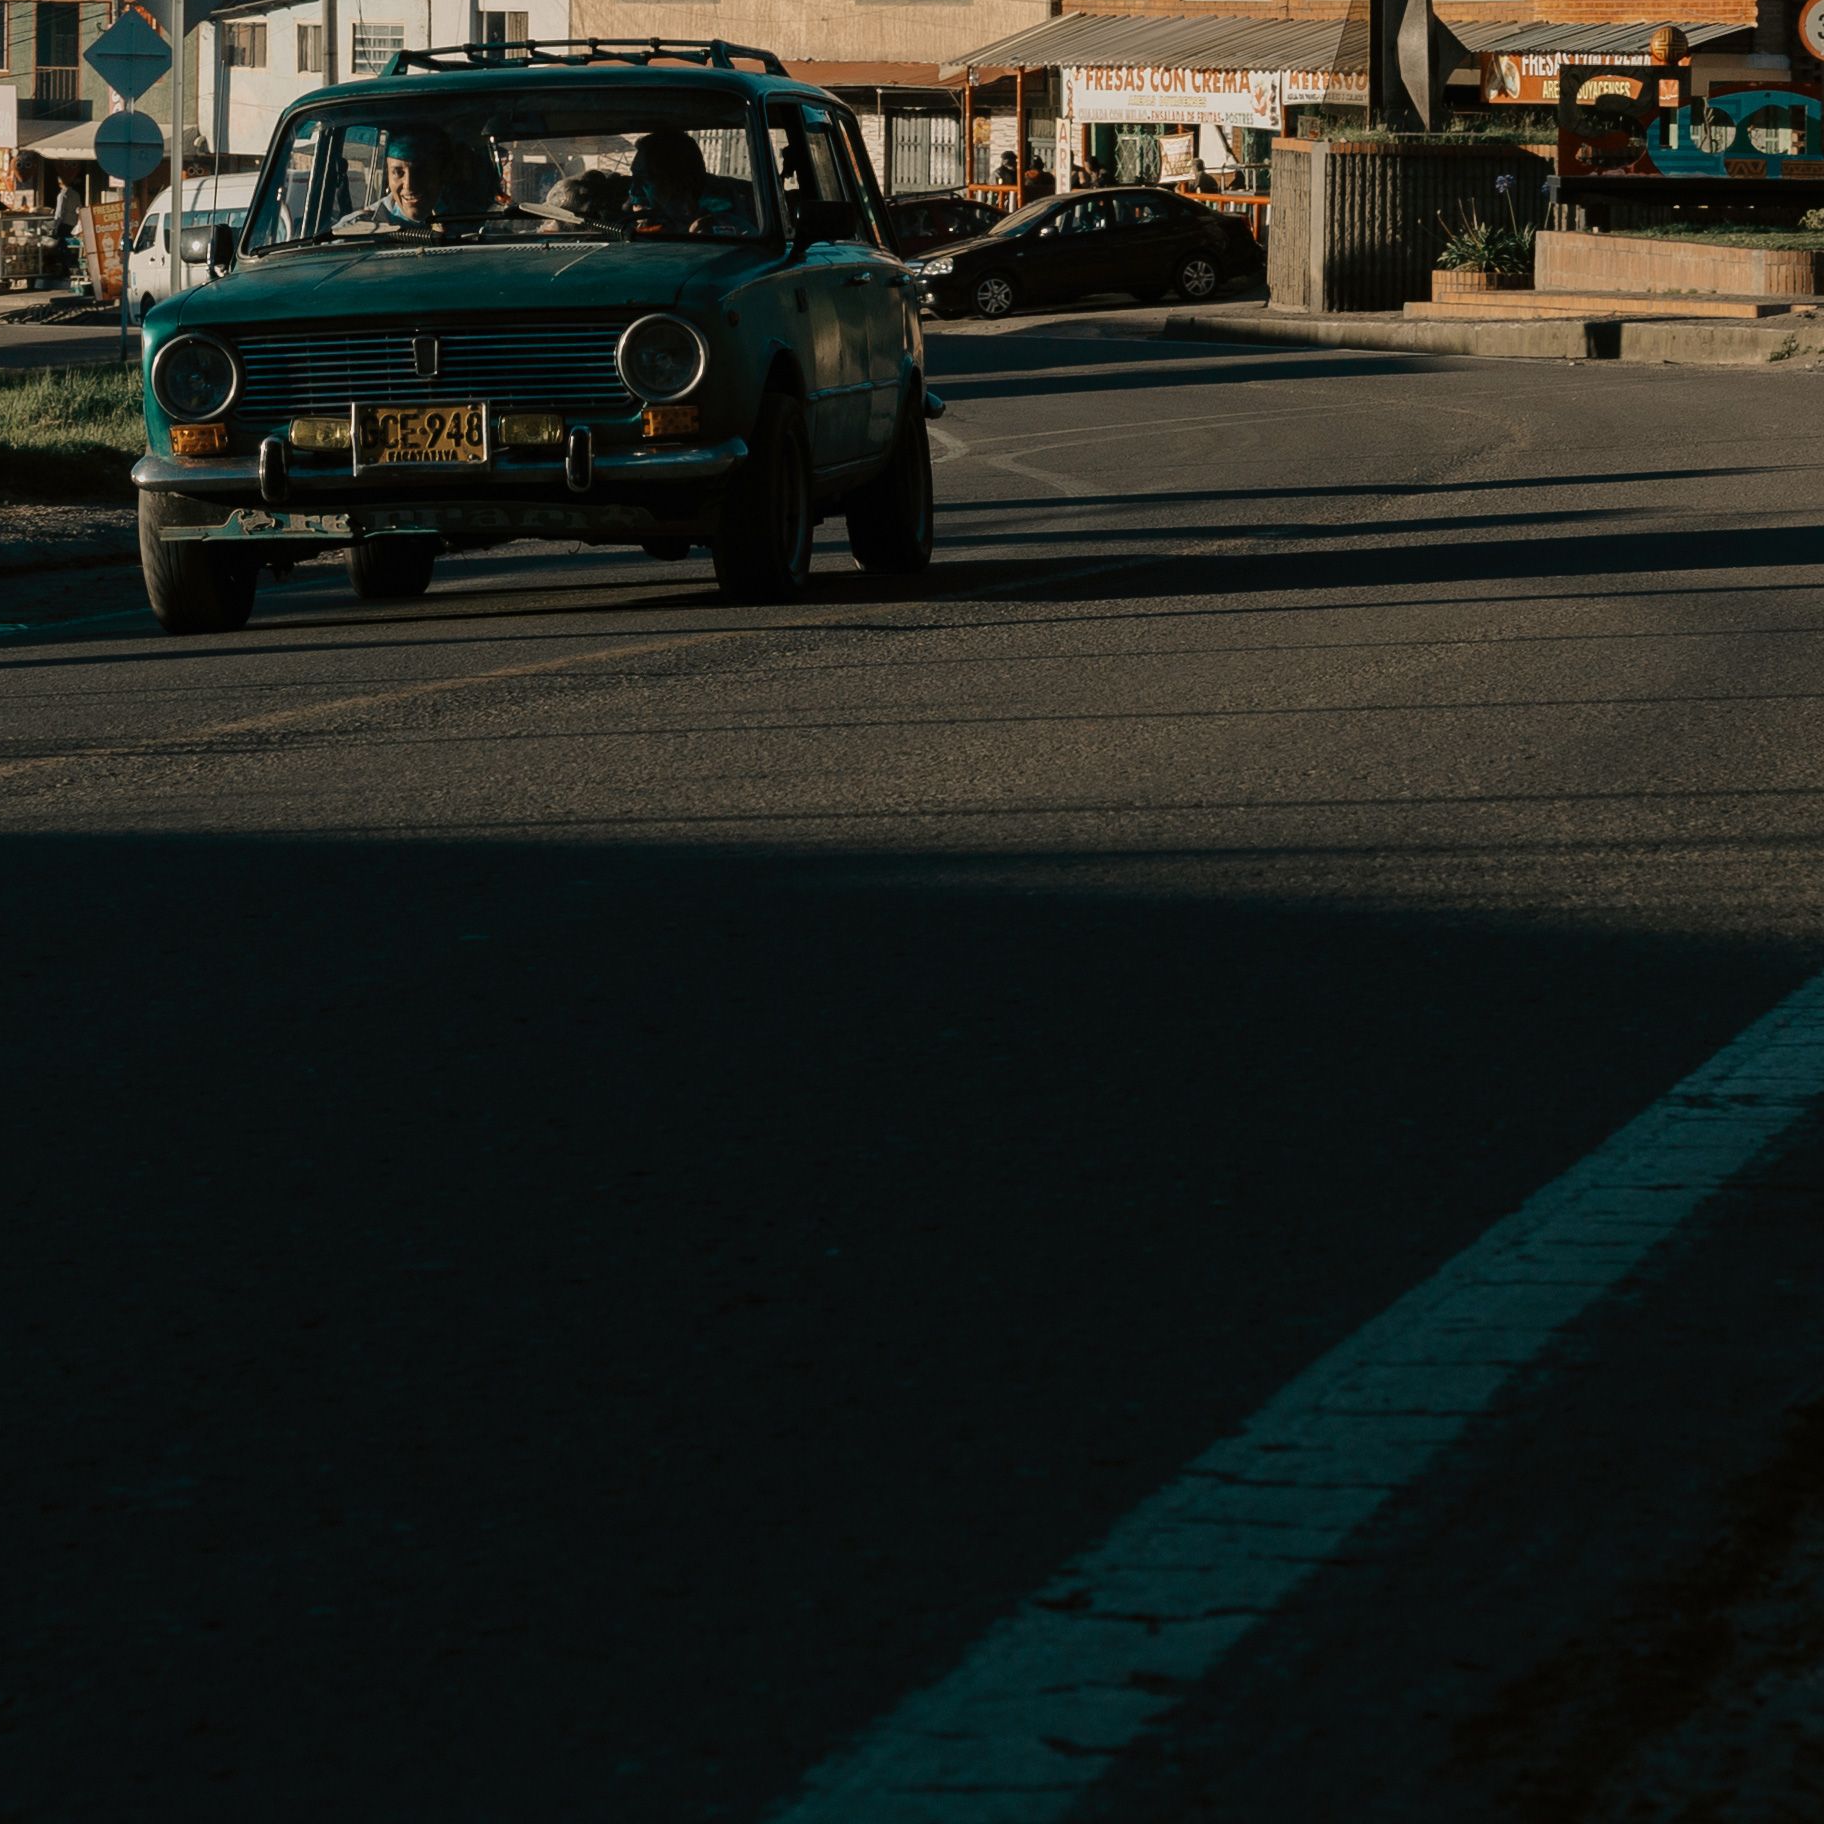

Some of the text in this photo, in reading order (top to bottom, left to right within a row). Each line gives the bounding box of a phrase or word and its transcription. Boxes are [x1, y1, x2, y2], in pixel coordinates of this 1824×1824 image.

[1086, 65, 1251, 94] FRESAS CON CREMA
